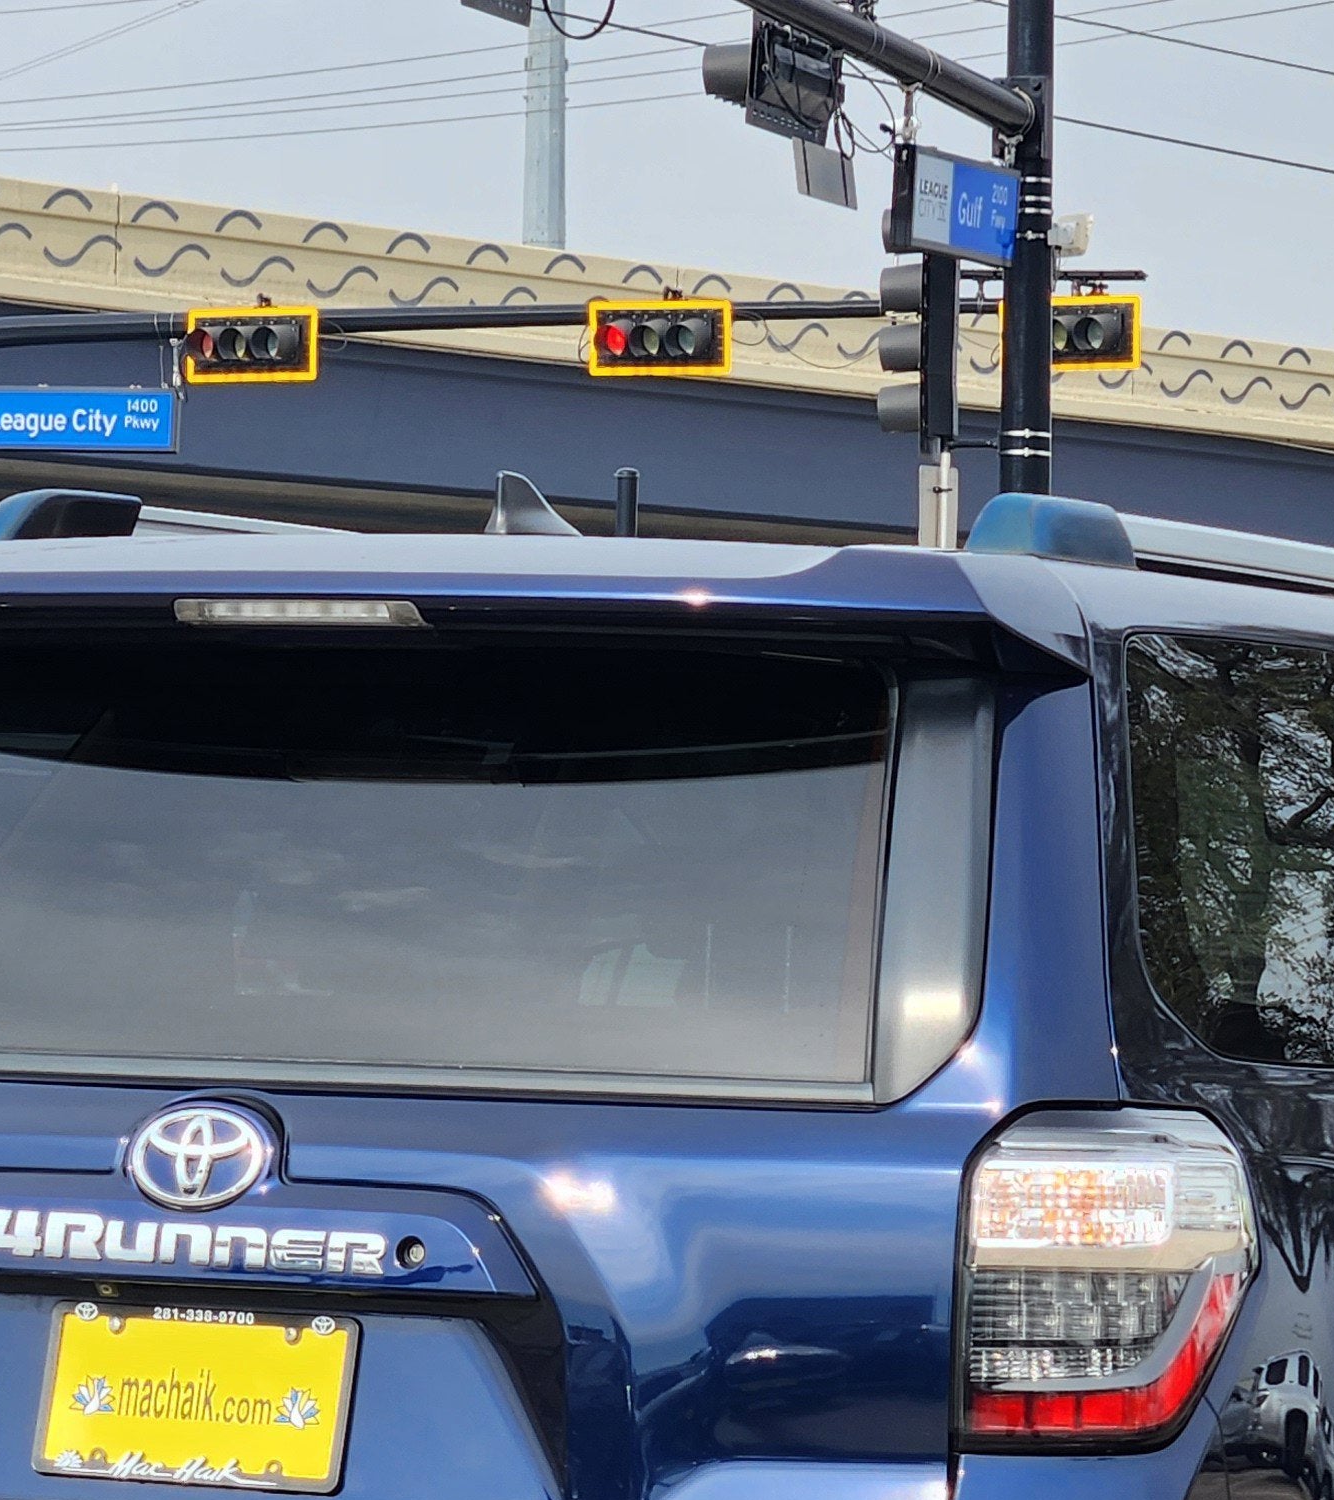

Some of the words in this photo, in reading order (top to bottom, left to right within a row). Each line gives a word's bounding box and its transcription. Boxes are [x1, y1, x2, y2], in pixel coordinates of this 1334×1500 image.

[919, 179, 948, 200] LEAGUE
[958, 191, 983, 229] Gulf
[126, 399, 158, 413] 1400
[72, 408, 118, 437] City
[124, 416, 160, 432] Pkwy
[117, 1368, 272, 1426] machaik.com
[108, 1451, 172, 1478] Mac
